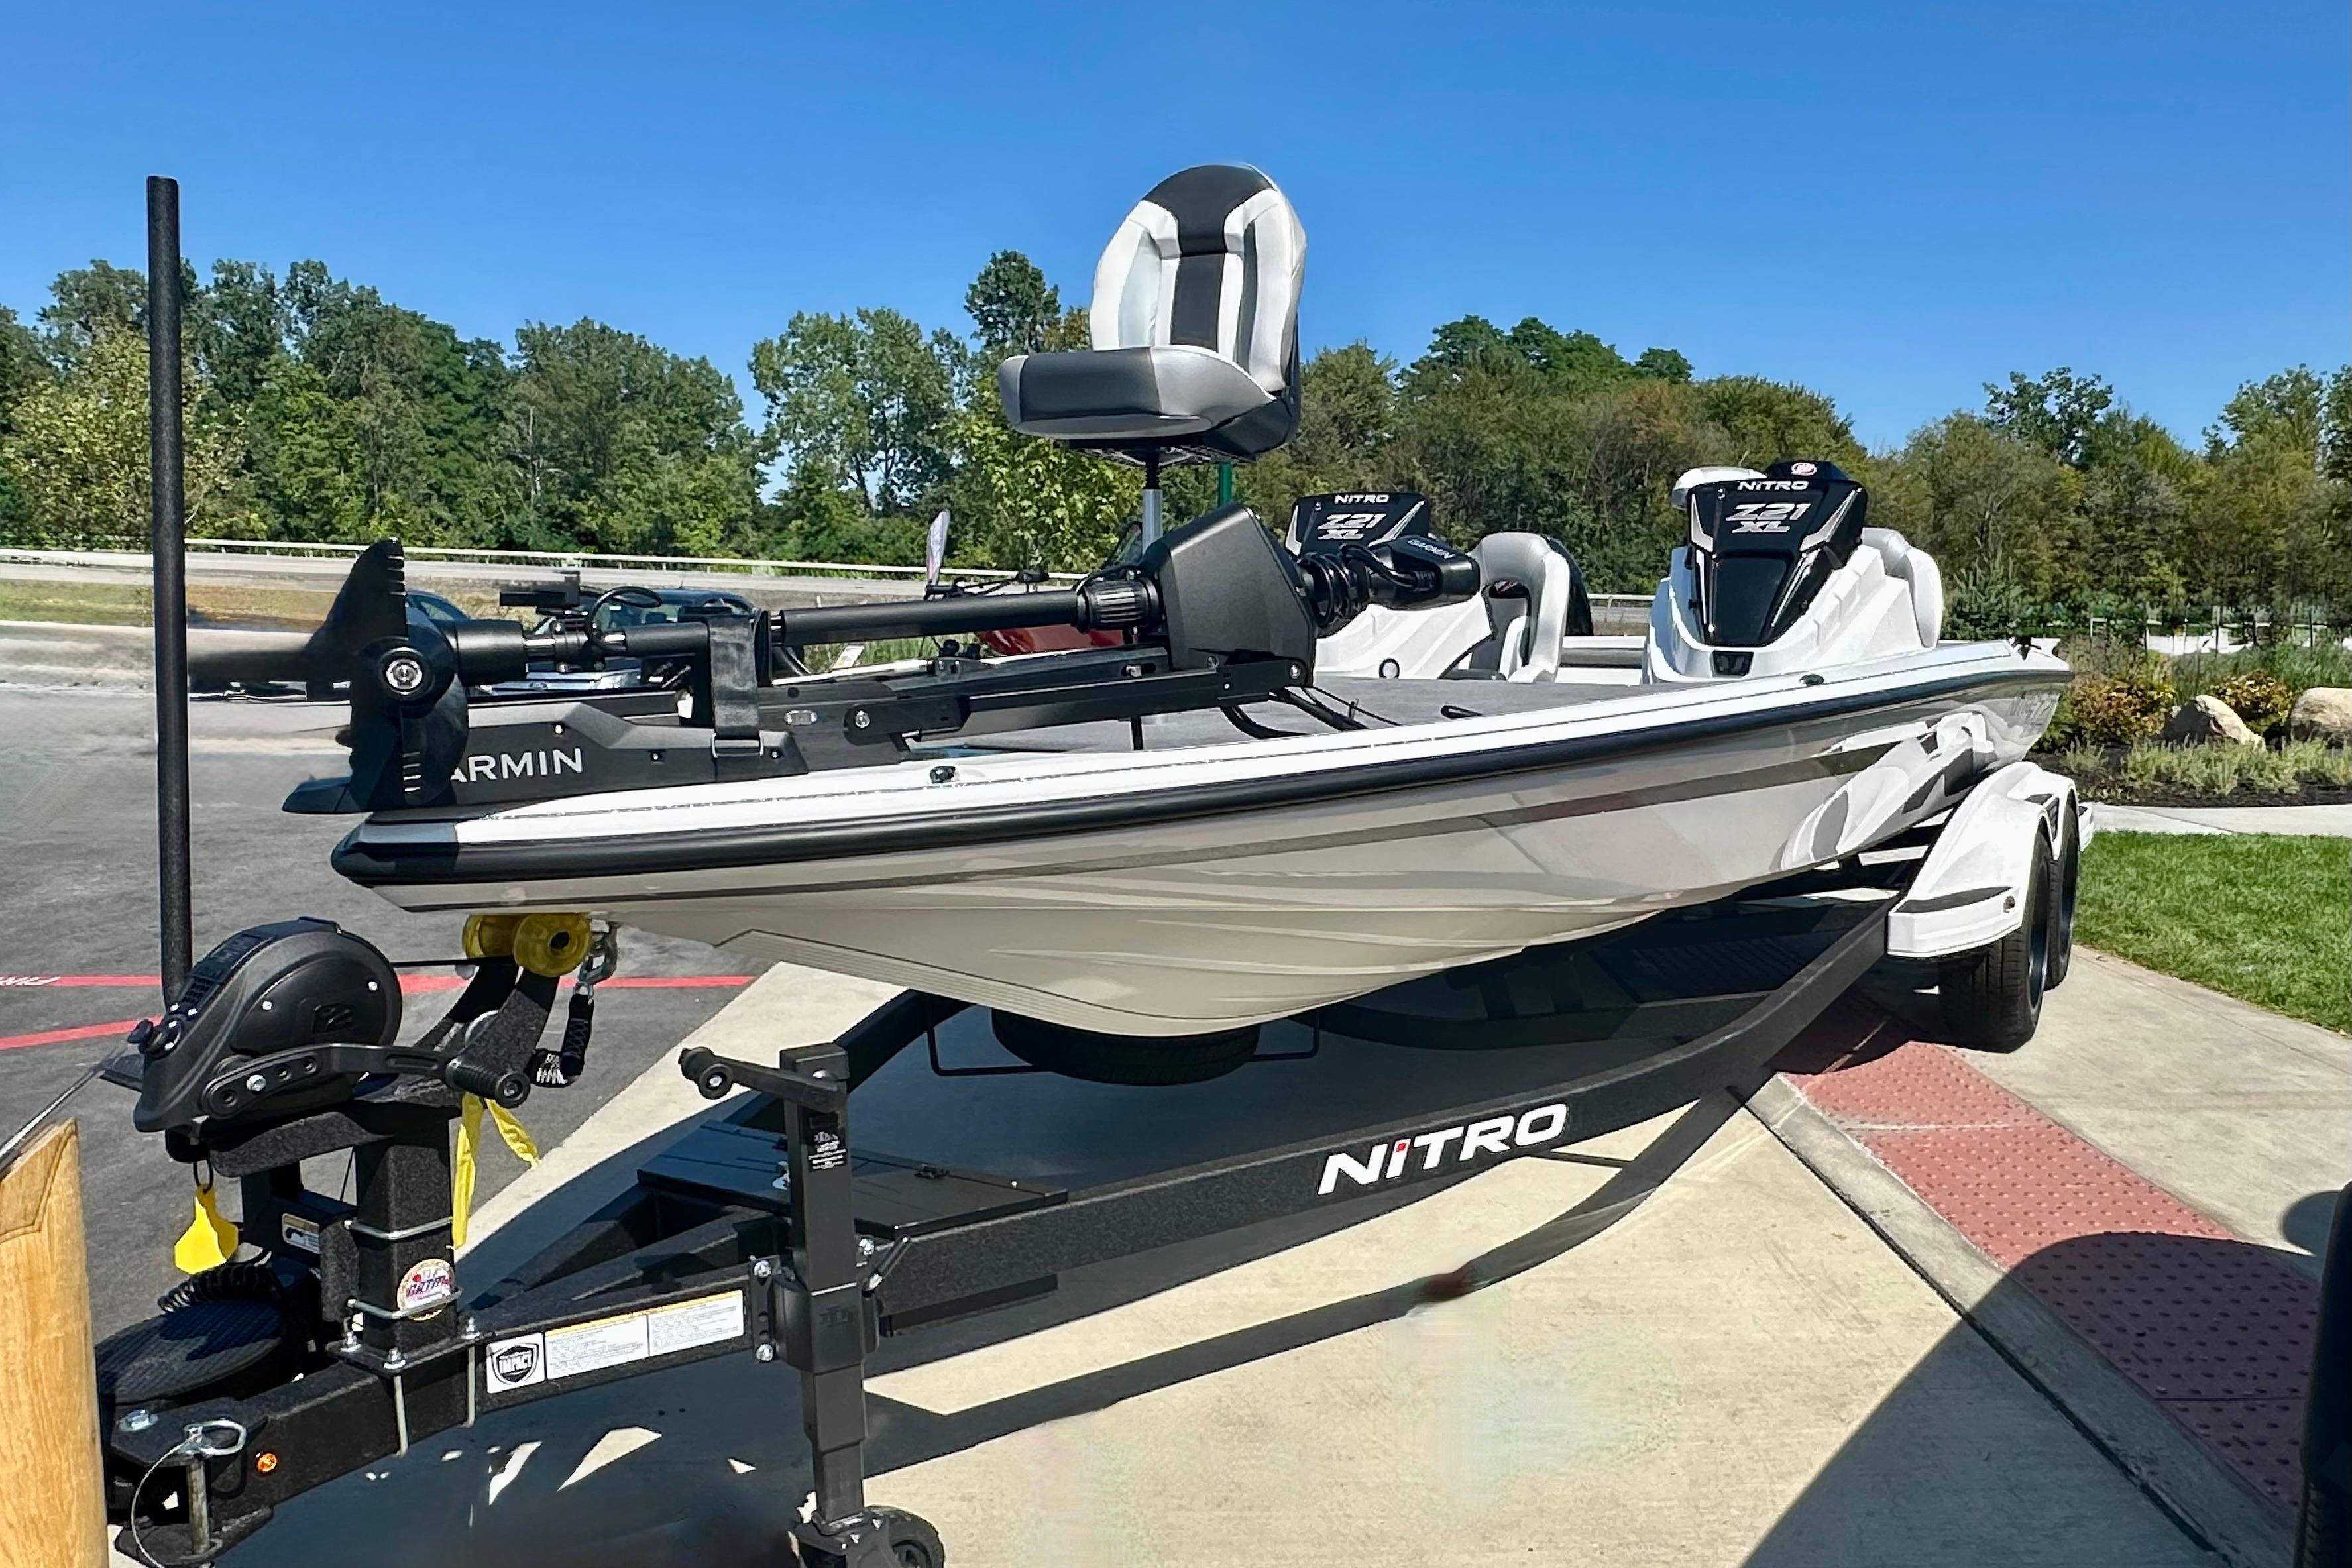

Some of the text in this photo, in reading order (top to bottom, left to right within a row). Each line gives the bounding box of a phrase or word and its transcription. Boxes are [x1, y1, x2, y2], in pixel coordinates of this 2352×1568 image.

[1738, 480, 1809, 491] NITRO
[1334, 494, 1389, 504] NITRO
[1726, 502, 1811, 522] Z21
[1317, 513, 1386, 530] Z21
[1731, 520, 1790, 533] XL
[1317, 529, 1365, 540] XL
[450, 748, 583, 783] ARMIN
[1317, 1103, 1568, 1195] NITRO
